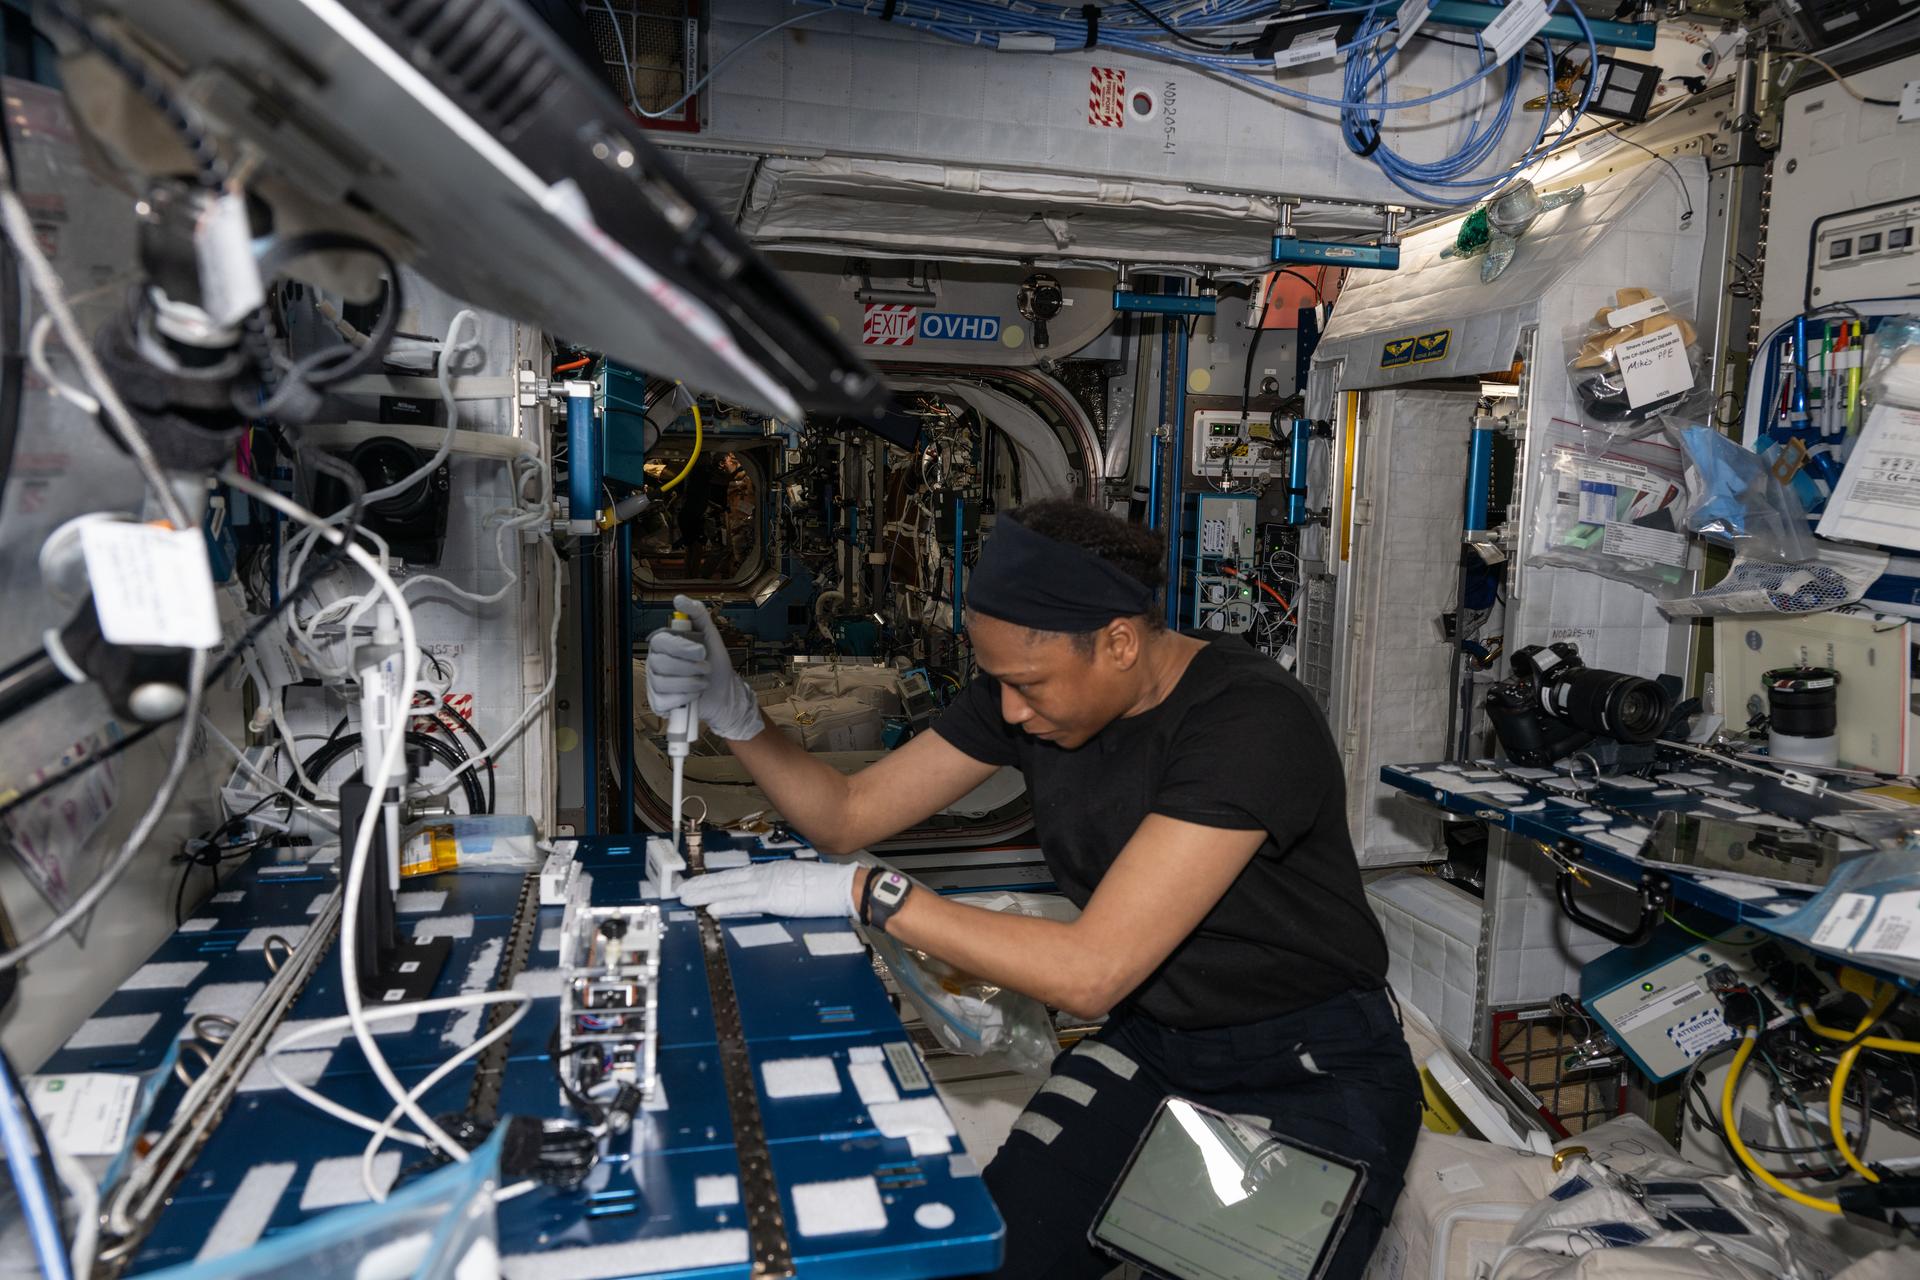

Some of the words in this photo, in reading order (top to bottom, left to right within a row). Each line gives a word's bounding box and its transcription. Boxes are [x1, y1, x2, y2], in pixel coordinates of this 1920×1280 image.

[871, 312, 909, 337] EXIT
[922, 314, 999, 340] OVHD
[1676, 1015, 1717, 1039] ATTENTION
